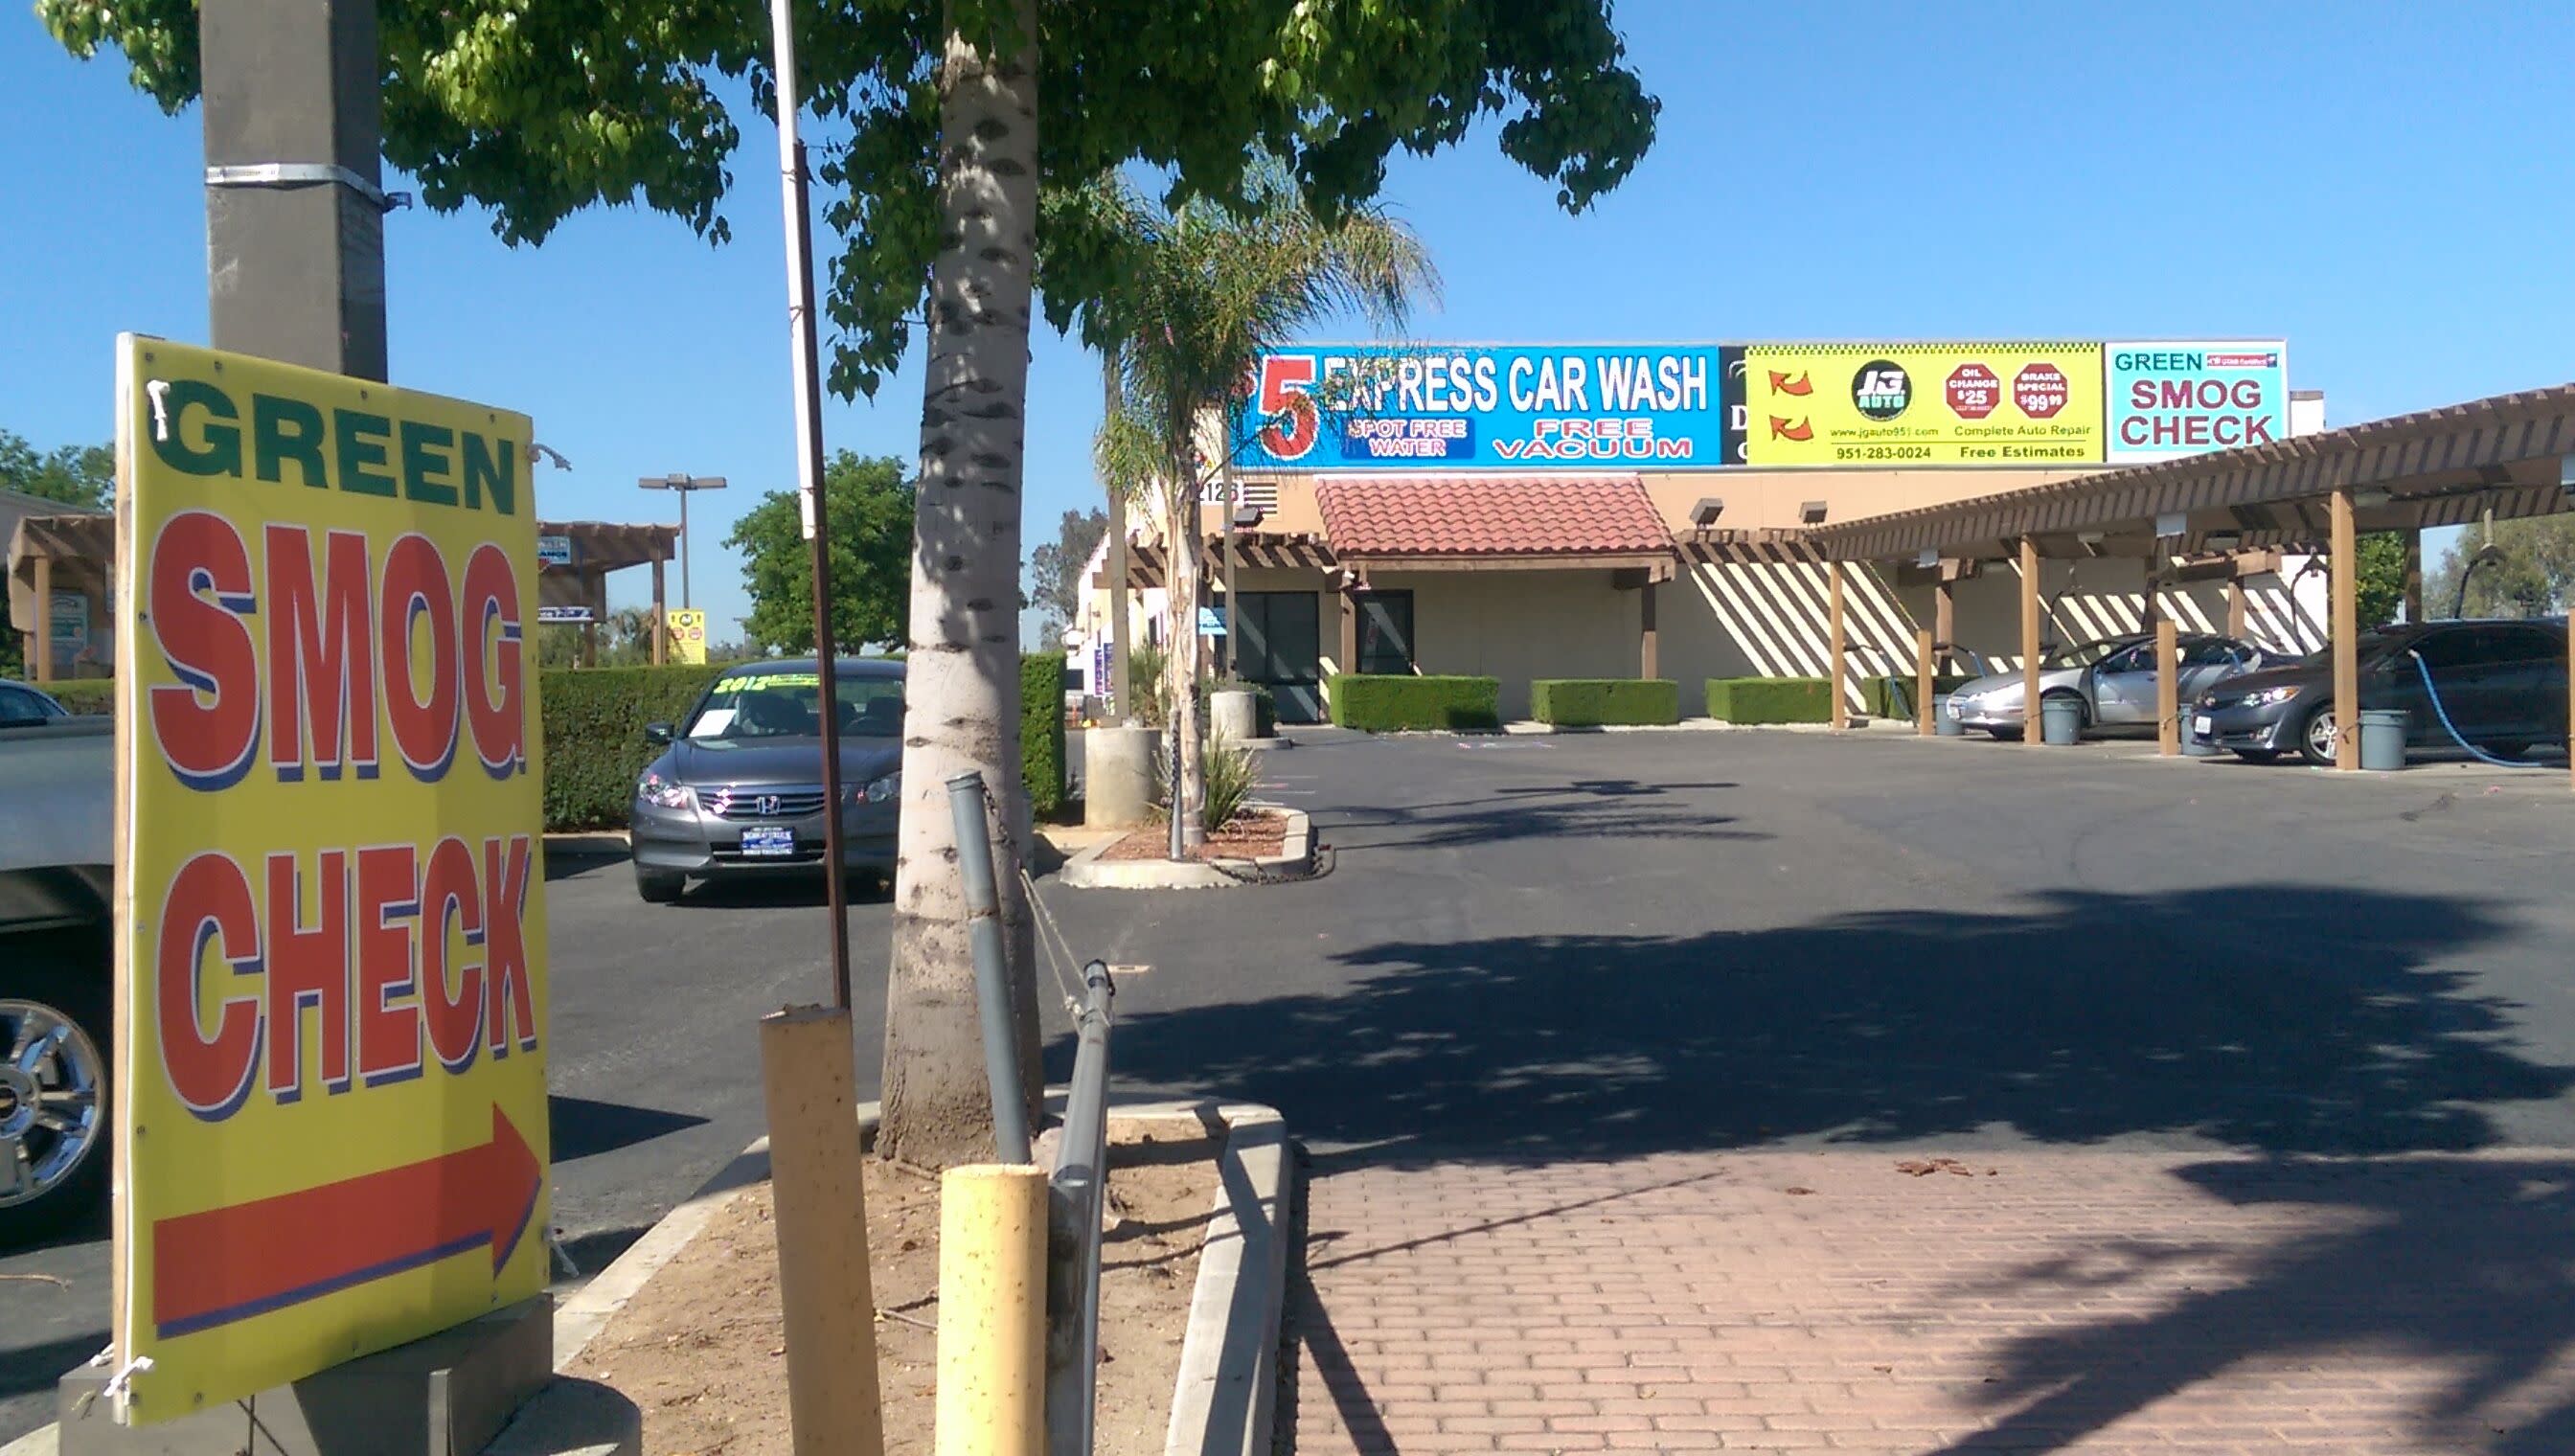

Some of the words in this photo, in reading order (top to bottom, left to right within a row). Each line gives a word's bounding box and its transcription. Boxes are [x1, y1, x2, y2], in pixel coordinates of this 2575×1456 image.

[2115, 353, 2202, 372] GREEN
[1961, 368, 1982, 377] OIL
[2020, 373, 2061, 381] BRAKE
[1324, 356, 1498, 413] EXPRESS
[1508, 355, 1589, 413] CAR
[1596, 355, 1707, 412] WASH
[1948, 379, 1998, 389] CHANGE
[2017, 382, 2065, 392] SPECIAL
[1858, 395, 1904, 408] AUTO
[1957, 390, 1988, 405] $25
[2131, 379, 2261, 410] SMOG
[1348, 419, 1408, 440] SPOT
[1408, 419, 1469, 439] FREE
[1534, 417, 1653, 440] FREE
[1954, 425, 2015, 437] Complete
[2017, 425, 2047, 436] Auto
[2050, 424, 2091, 437] Repair
[2121, 415, 2273, 446] CHECK
[148, 379, 515, 515] GREEN
[1368, 438, 1447, 458] WATER
[1492, 438, 1694, 460] VACUUM
[1836, 446, 1931, 460] 951-283-0024
[1960, 446, 1997, 458] Free
[2002, 445, 2085, 458] Estimates
[149, 509, 527, 792] SMOG
[156, 833, 538, 1123] CHECK
